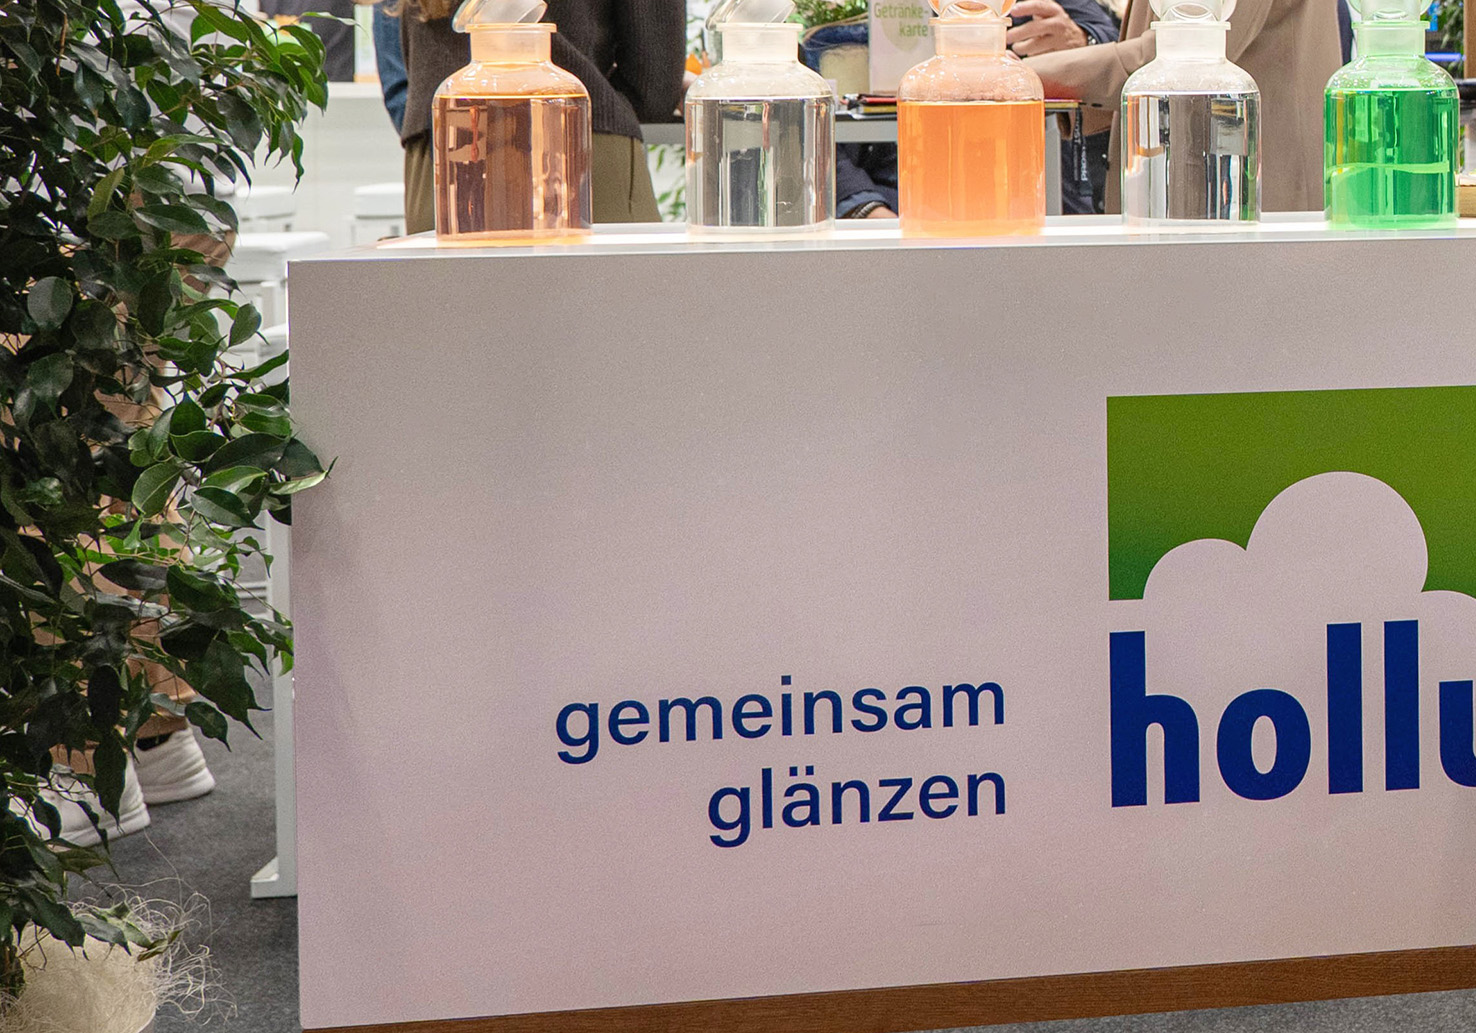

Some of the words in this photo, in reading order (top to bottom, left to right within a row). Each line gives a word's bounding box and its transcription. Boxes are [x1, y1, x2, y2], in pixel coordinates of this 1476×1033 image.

[873, 2, 929, 18] Getränke-
[899, 21, 929, 37] karte
[556, 674, 1005, 764] gemeinsam
[708, 765, 1006, 848] glänzen
